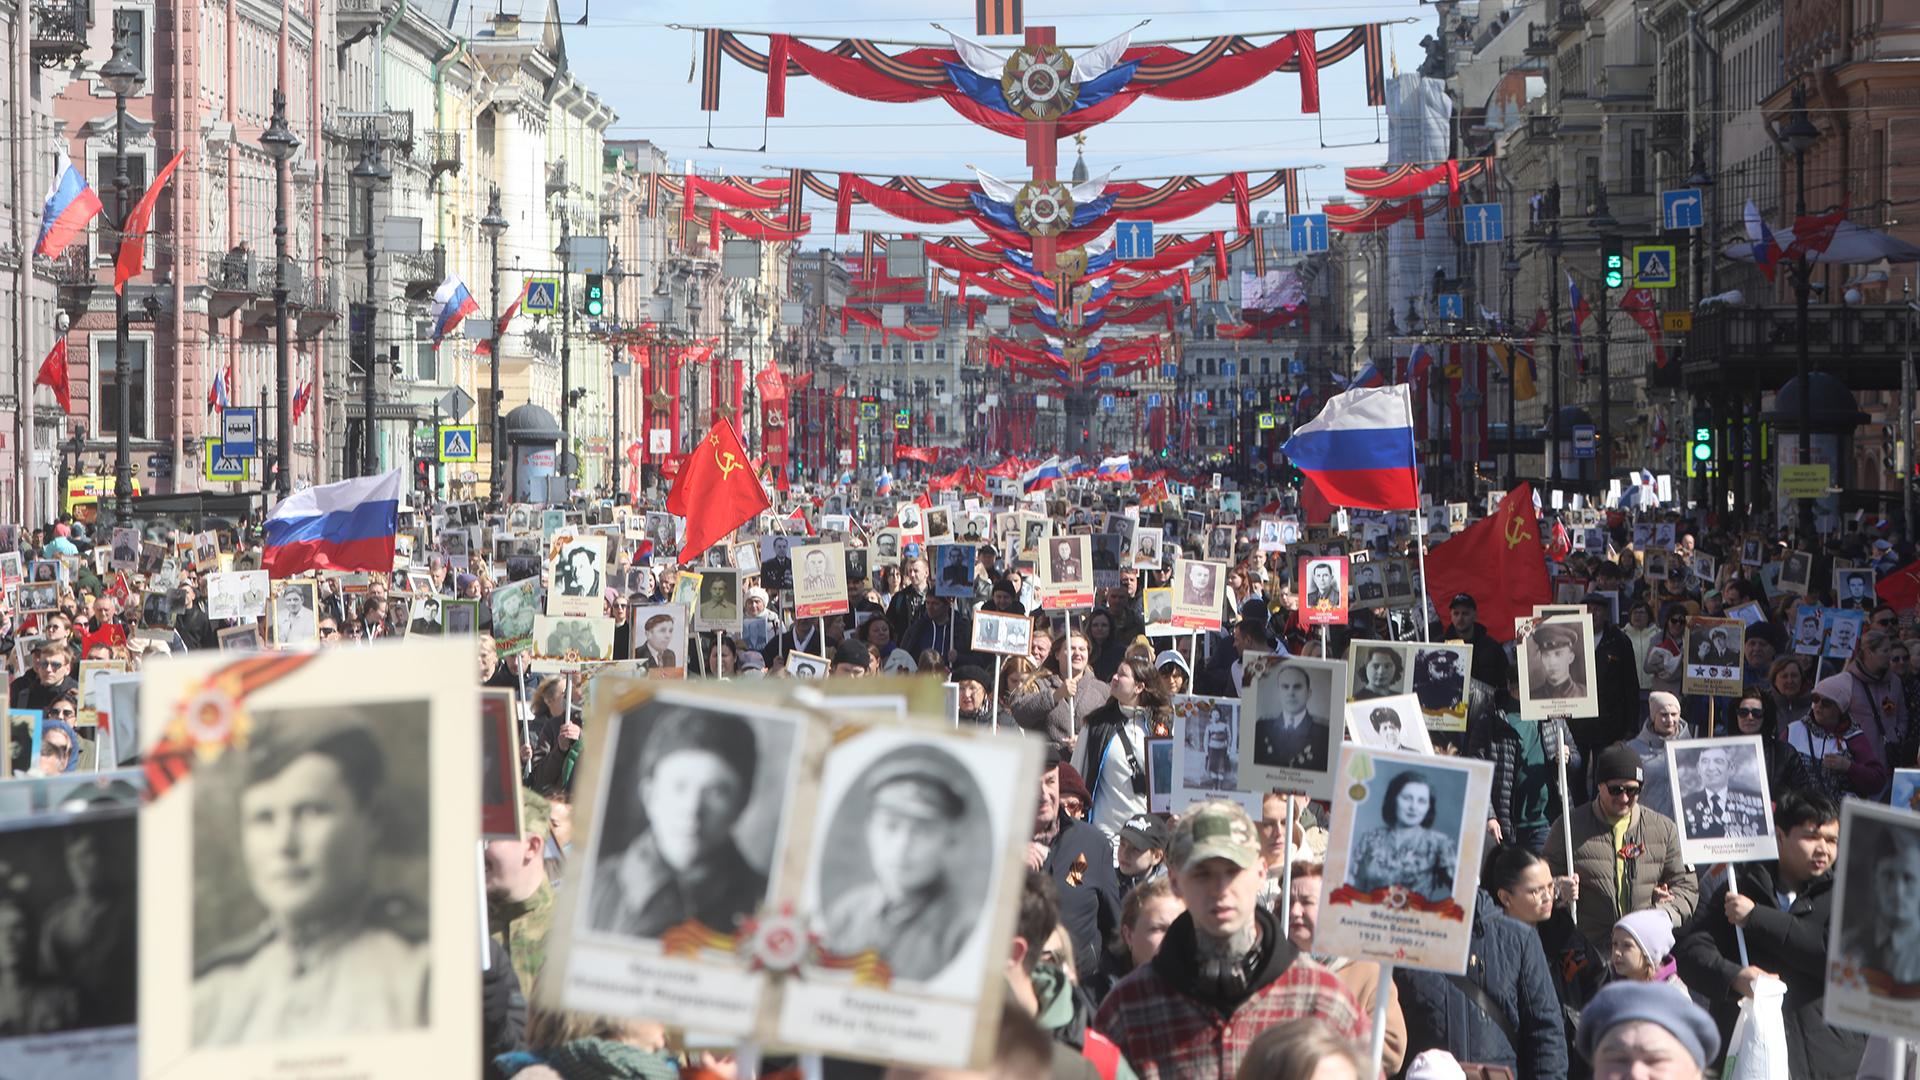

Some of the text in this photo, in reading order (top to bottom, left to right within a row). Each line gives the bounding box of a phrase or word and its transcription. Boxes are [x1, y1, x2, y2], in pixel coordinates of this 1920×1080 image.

[1608, 255, 1621, 268] 25
[1672, 319, 1684, 328] 10
[1696, 428, 1710, 441] 25
